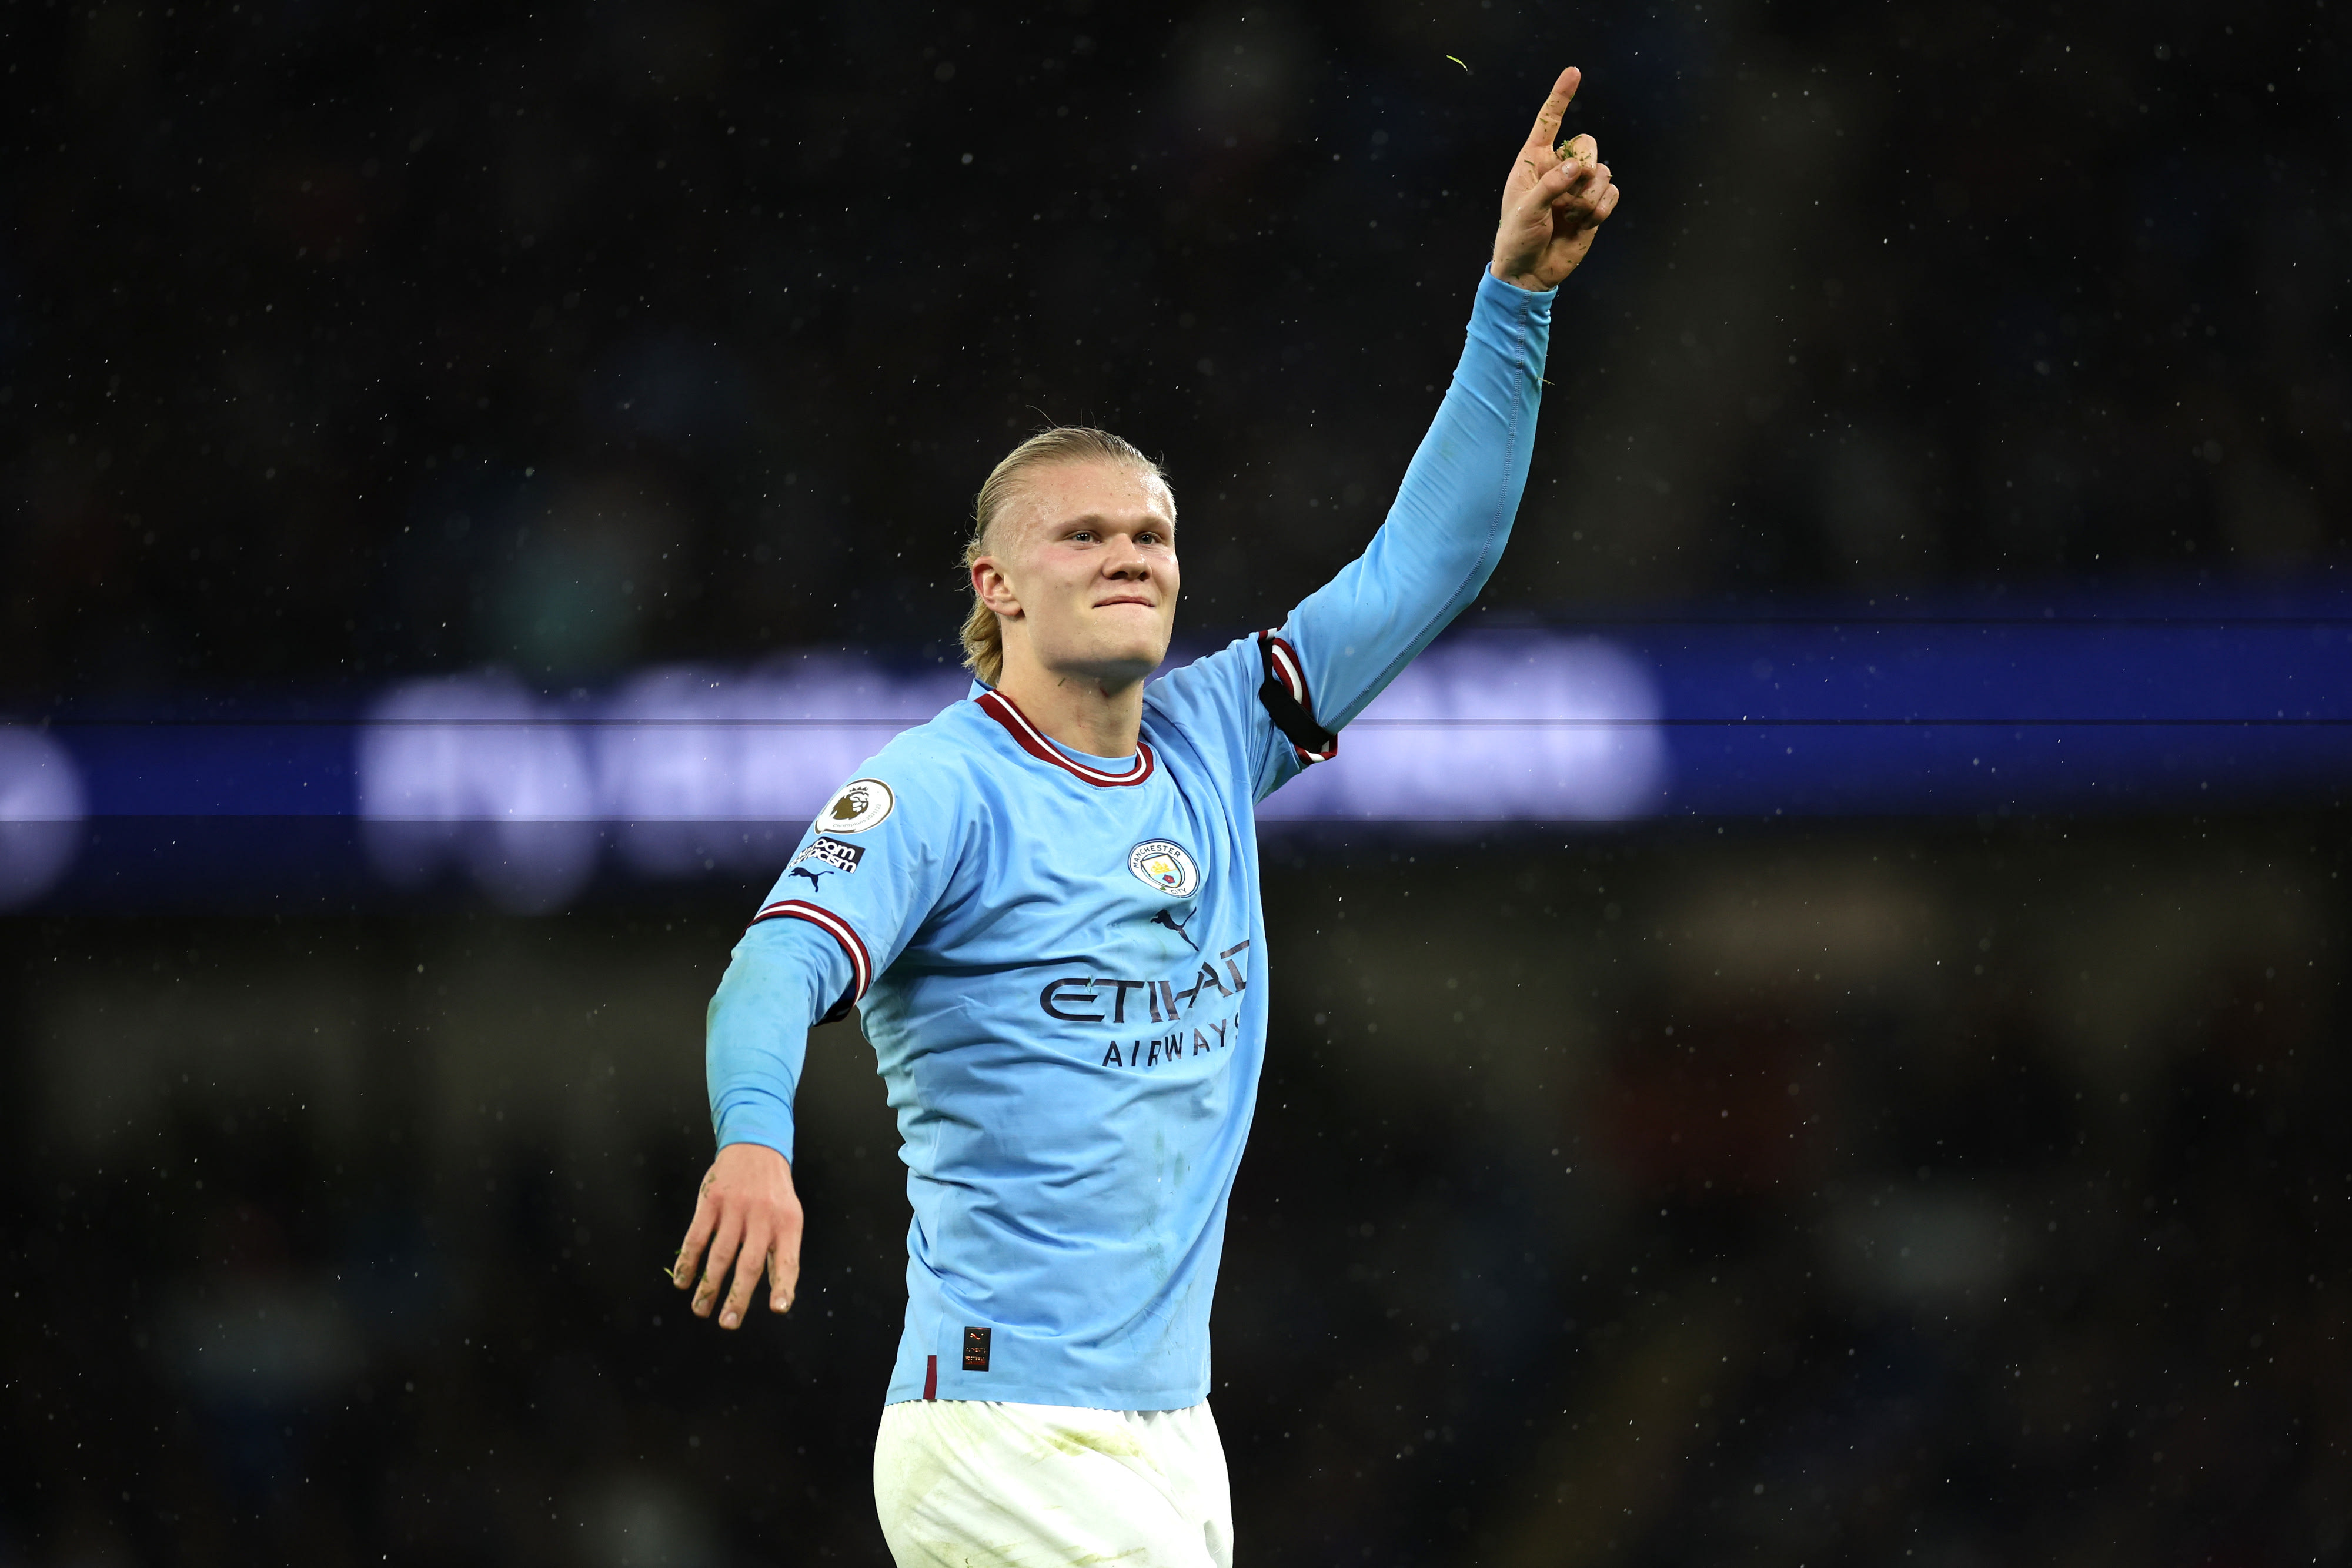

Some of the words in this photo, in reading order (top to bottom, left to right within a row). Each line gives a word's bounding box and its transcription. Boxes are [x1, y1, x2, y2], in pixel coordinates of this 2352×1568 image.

[833, 820, 866, 828] Champions
[866, 804, 881, 821] 2021/22
[1133, 845, 1181, 868] MANCHESTER
